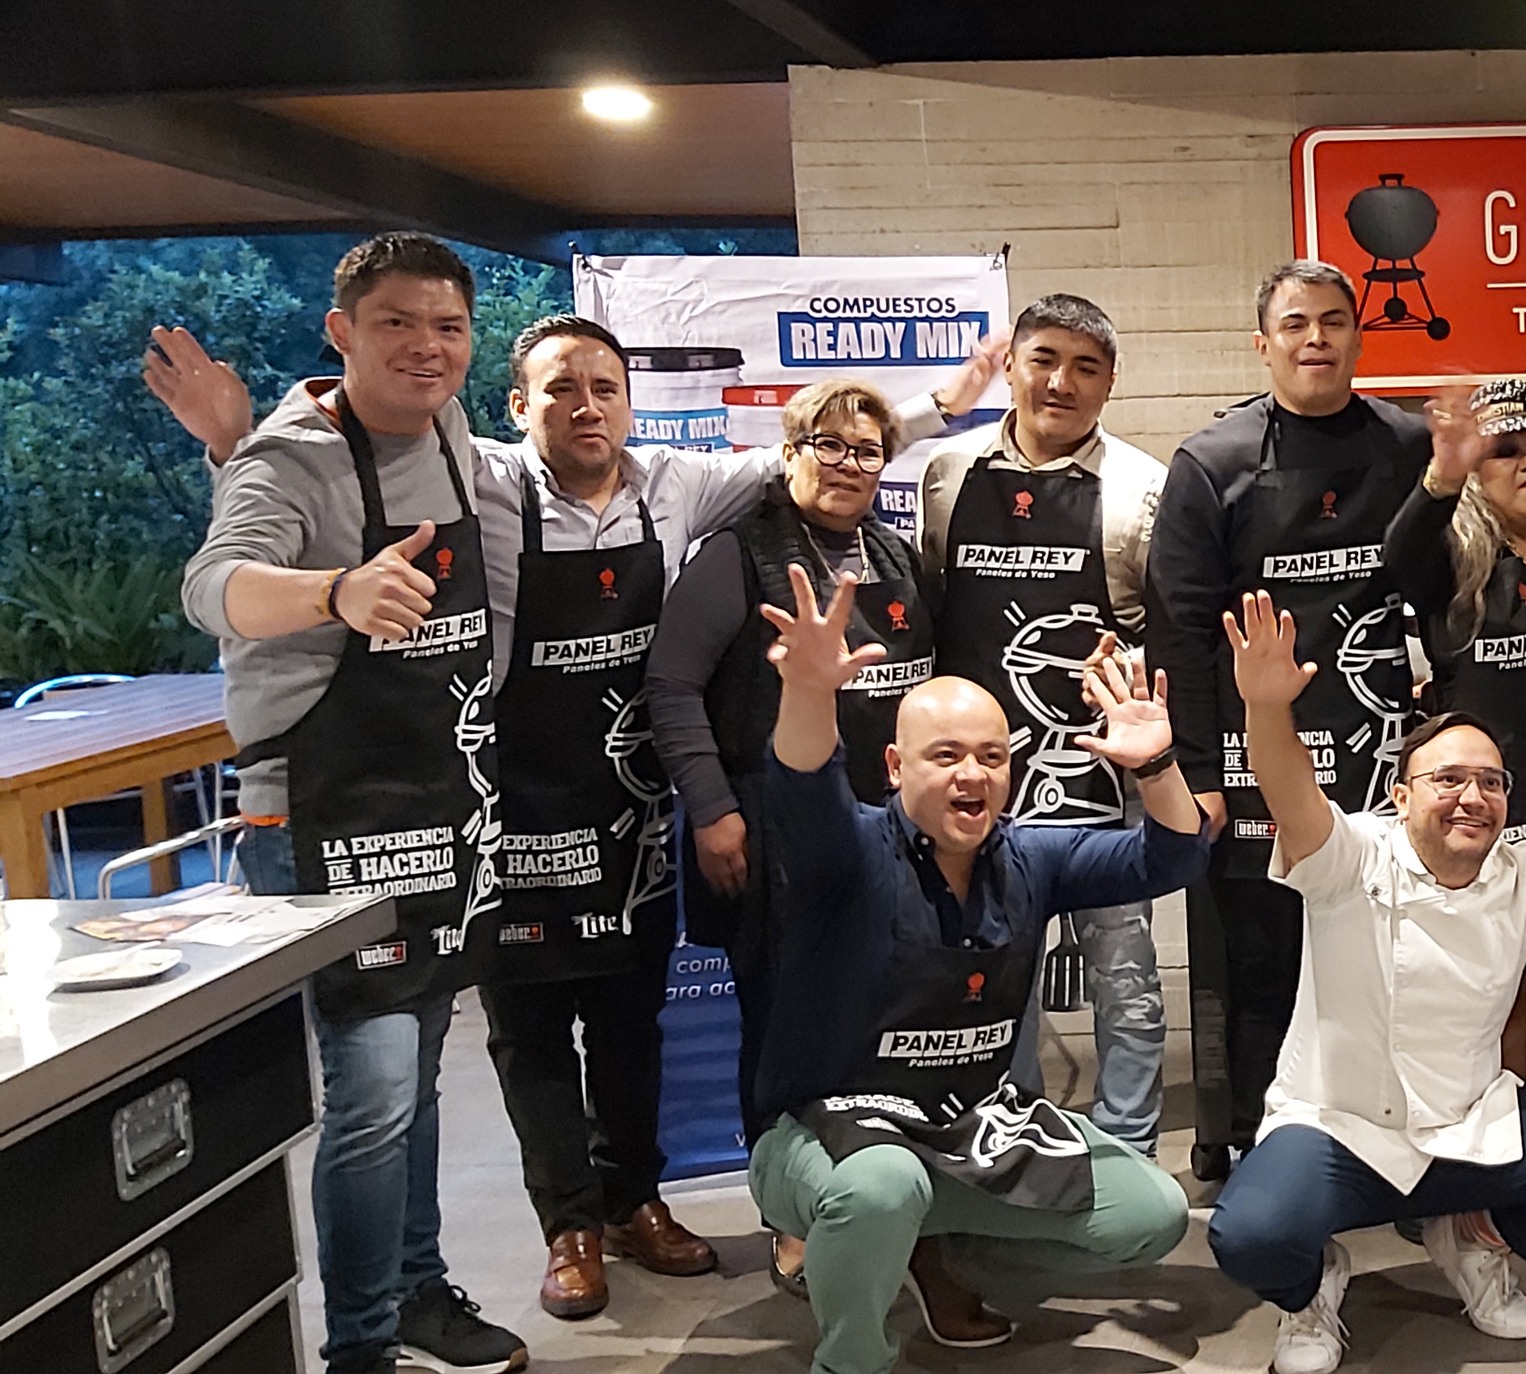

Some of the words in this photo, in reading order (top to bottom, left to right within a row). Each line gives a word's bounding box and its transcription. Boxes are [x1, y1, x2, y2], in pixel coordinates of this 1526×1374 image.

[809, 297, 956, 314] COMPUESTOS
[790, 321, 906, 359] READY
[916, 321, 981, 358] MIX
[688, 415, 726, 439] MIX
[880, 488, 917, 513] REA
[963, 549, 1025, 564] PANEL
[1030, 550, 1076, 566] REY
[1273, 553, 1339, 573] PANEL
[1346, 546, 1384, 566] REY
[976, 568, 1012, 578] Paneles
[1014, 569, 1027, 578] de
[1030, 570, 1055, 579] Yeso
[1333, 573, 1345, 581] de
[383, 621, 454, 644] ANEL
[544, 639, 616, 660] PANEL
[621, 628, 651, 650] REY
[562, 661, 606, 674] Paneles
[608, 658, 620, 667] de
[852, 665, 909, 683] PANEL
[1223, 732, 1240, 748] LA
[1224, 753, 1242, 767] DE
[322, 839, 349, 858] LA
[350, 826, 454, 855] EXPERIENCIA
[502, 827, 598, 850] EXPERIENCIA
[327, 863, 354, 881] DE
[359, 847, 454, 881] HACERLO
[507, 845, 599, 874] HACERLO
[571, 912, 619, 938] Lite
[892, 1033, 967, 1052] PANEL
[973, 1024, 1009, 1048] REY
[909, 1057, 954, 1068] Paneles
[957, 1055, 969, 1065] de
